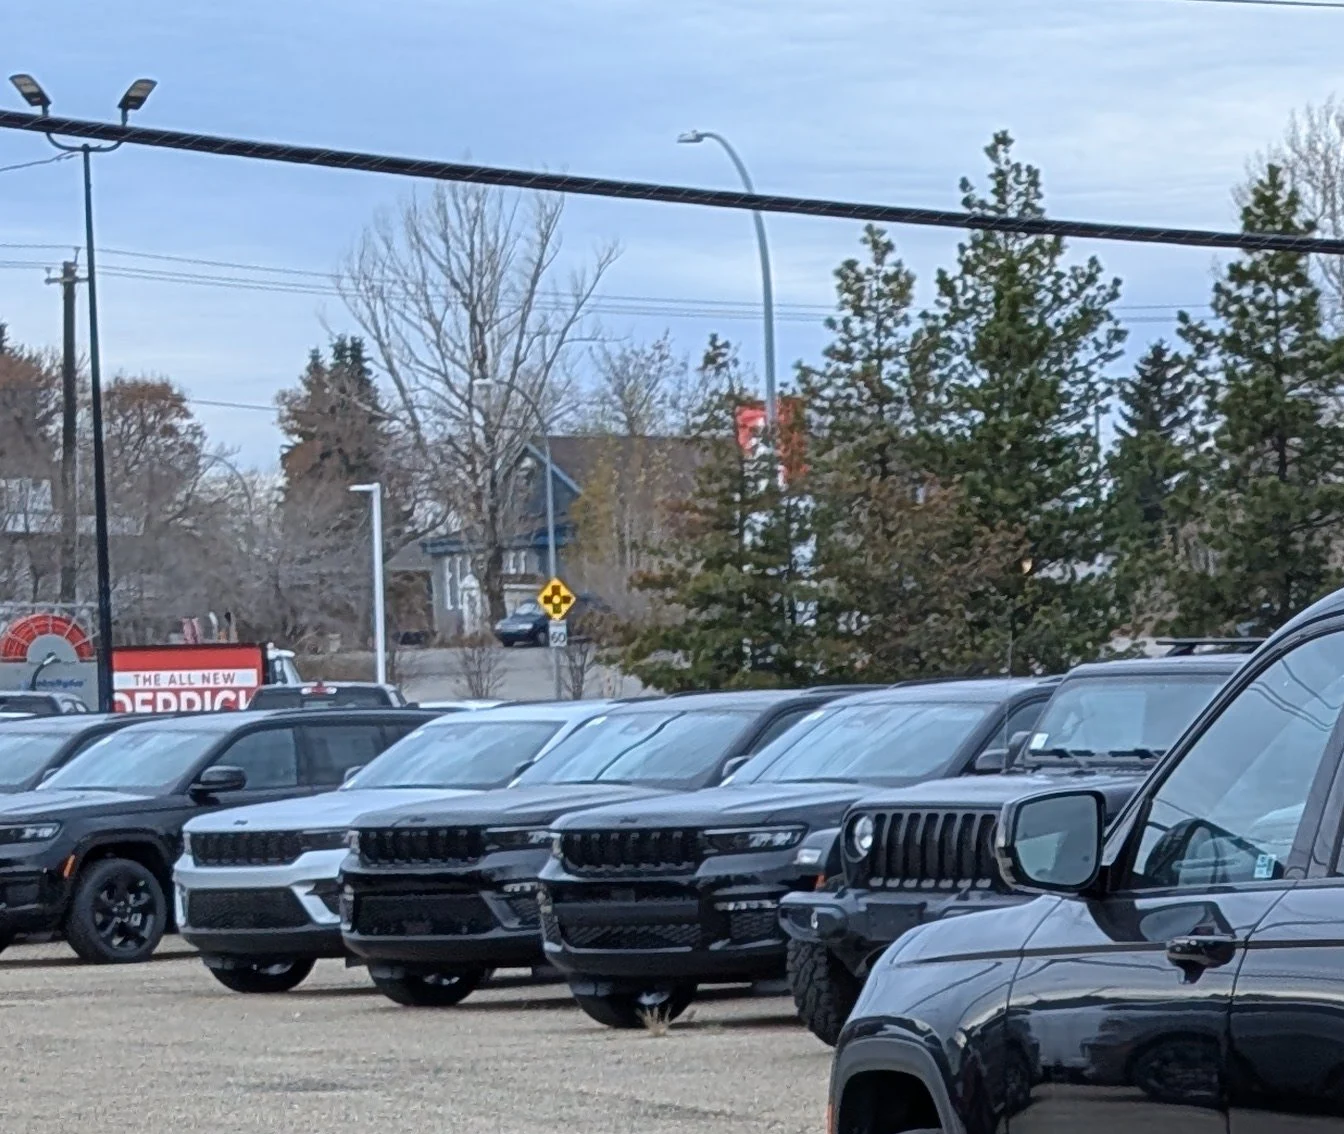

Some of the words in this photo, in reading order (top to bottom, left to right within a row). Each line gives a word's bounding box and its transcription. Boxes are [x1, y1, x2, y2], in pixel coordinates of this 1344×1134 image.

[551, 632, 566, 644] 60
[133, 673, 161, 687] THE
[168, 673, 195, 686] ALL
[201, 672, 236, 685] NEW
